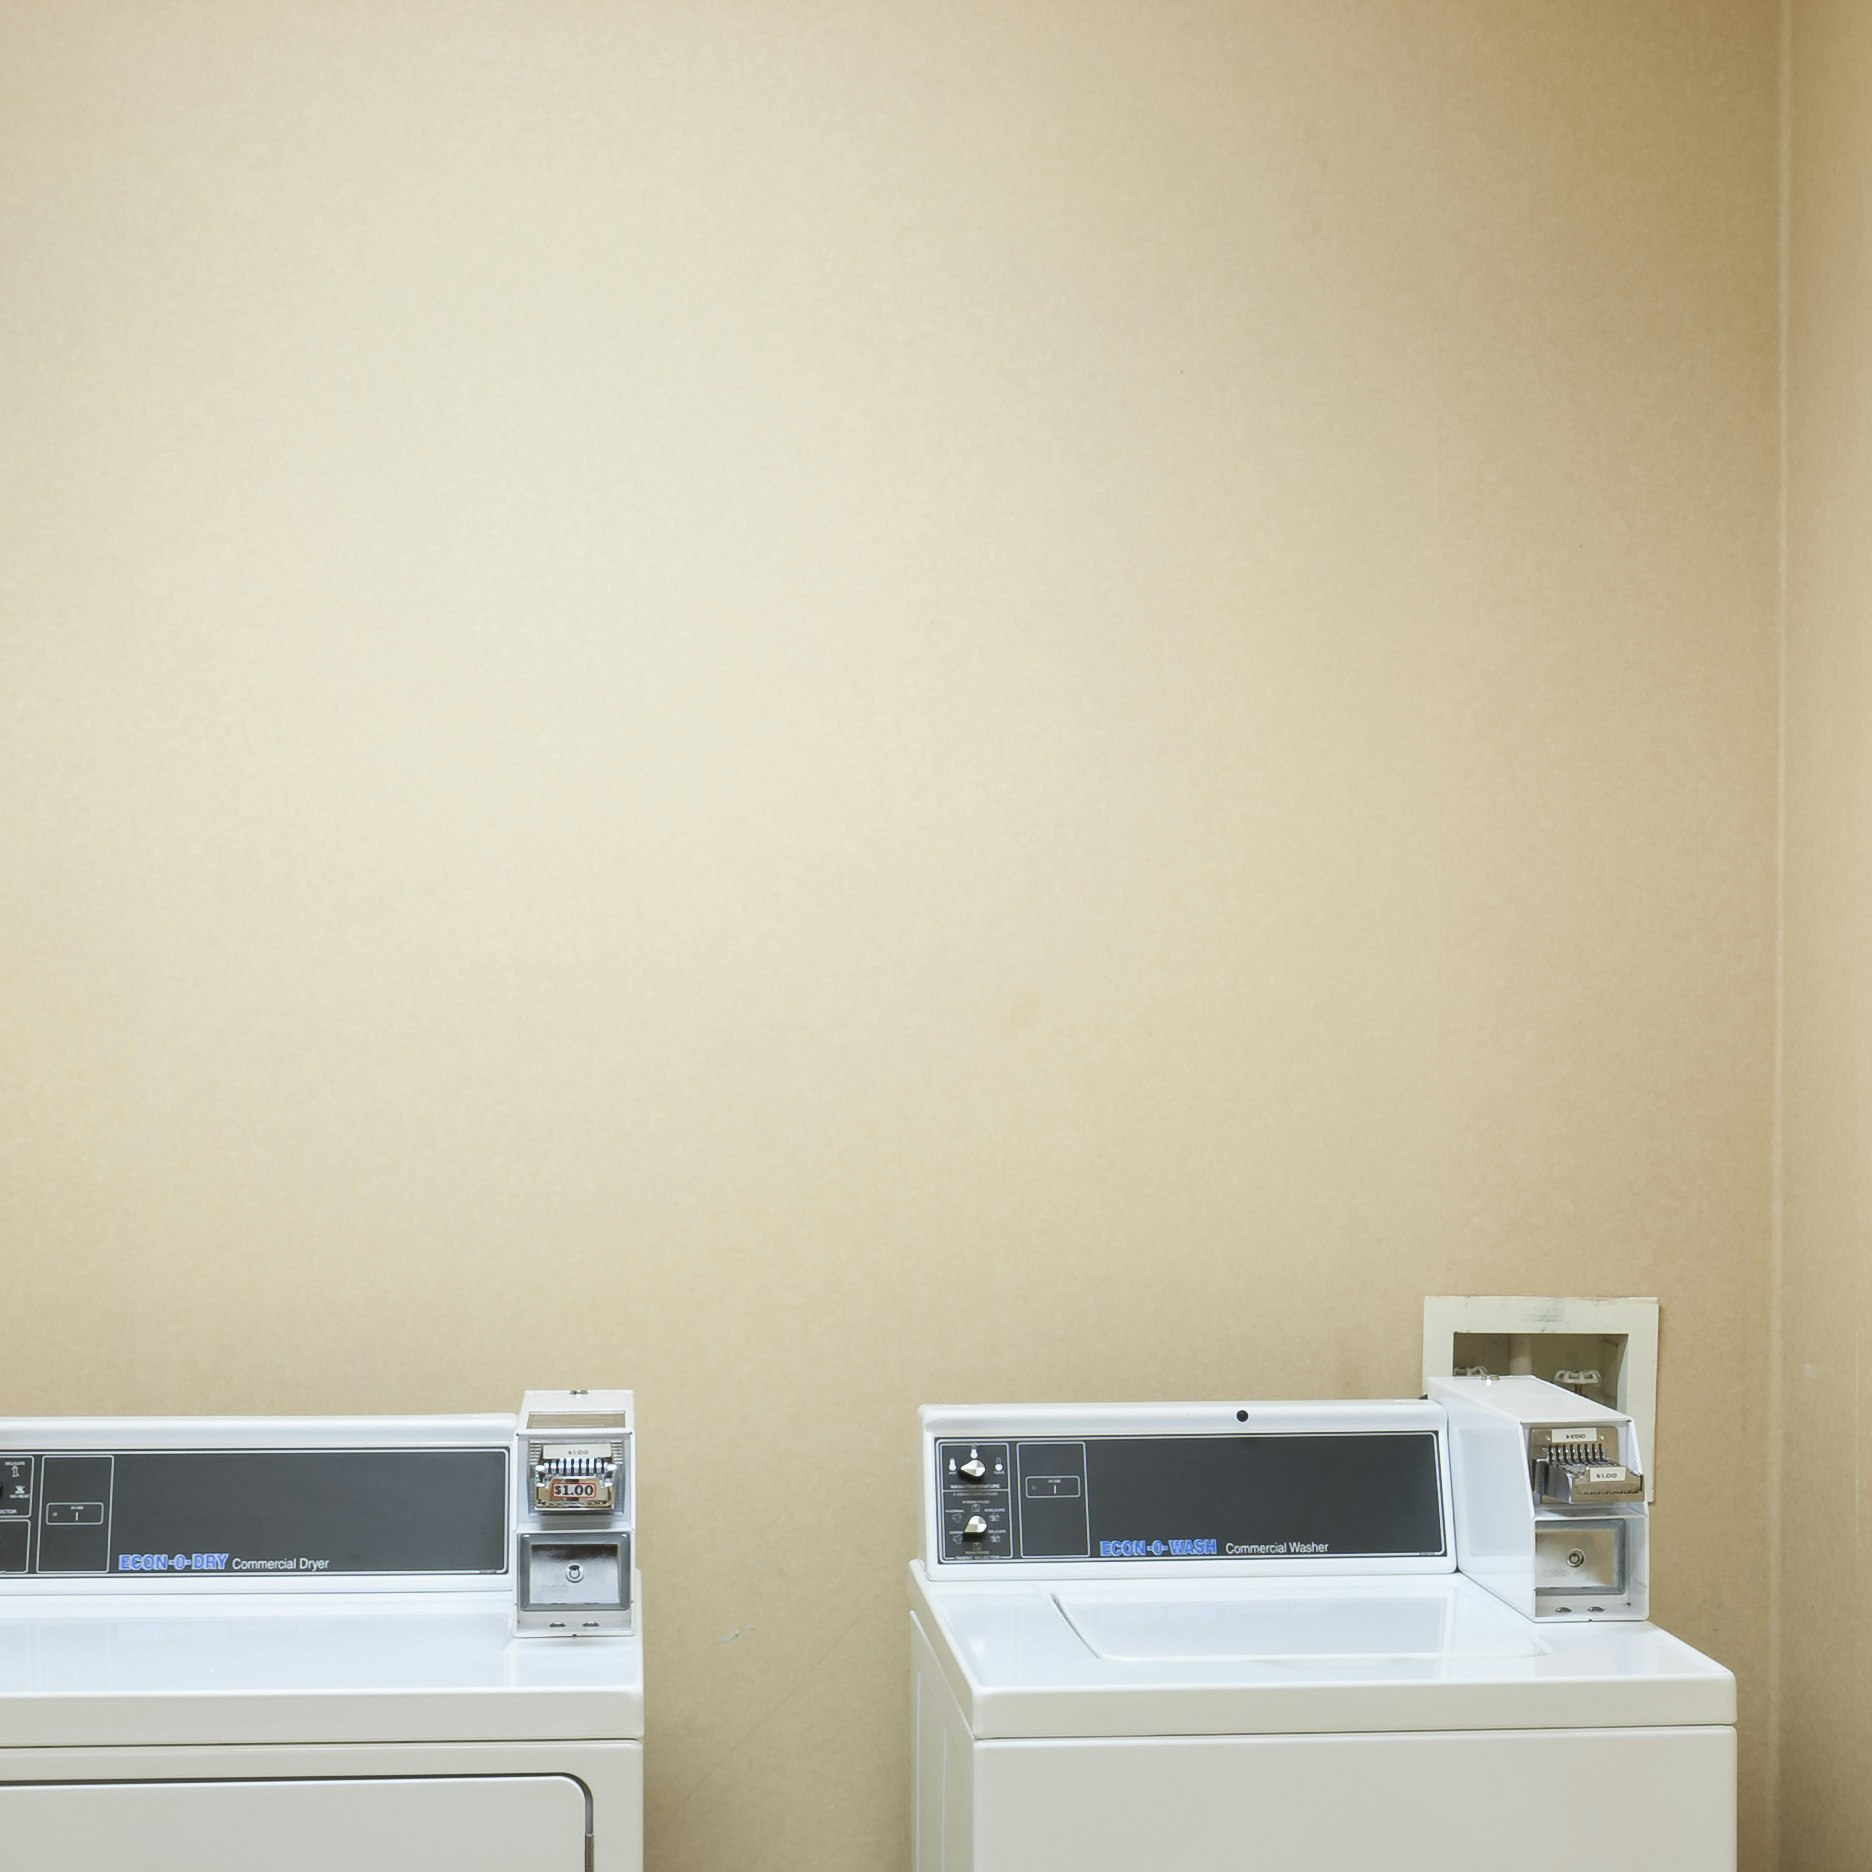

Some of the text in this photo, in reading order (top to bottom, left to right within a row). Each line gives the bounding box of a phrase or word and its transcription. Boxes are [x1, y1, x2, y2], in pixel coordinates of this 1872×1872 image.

[554, 1484, 594, 1496] $1.00
[1099, 1538, 1329, 1556] ECON-O-WASH Commercial Washer
[118, 1553, 330, 1572] ECON-O-DRY Commercial Dryer
